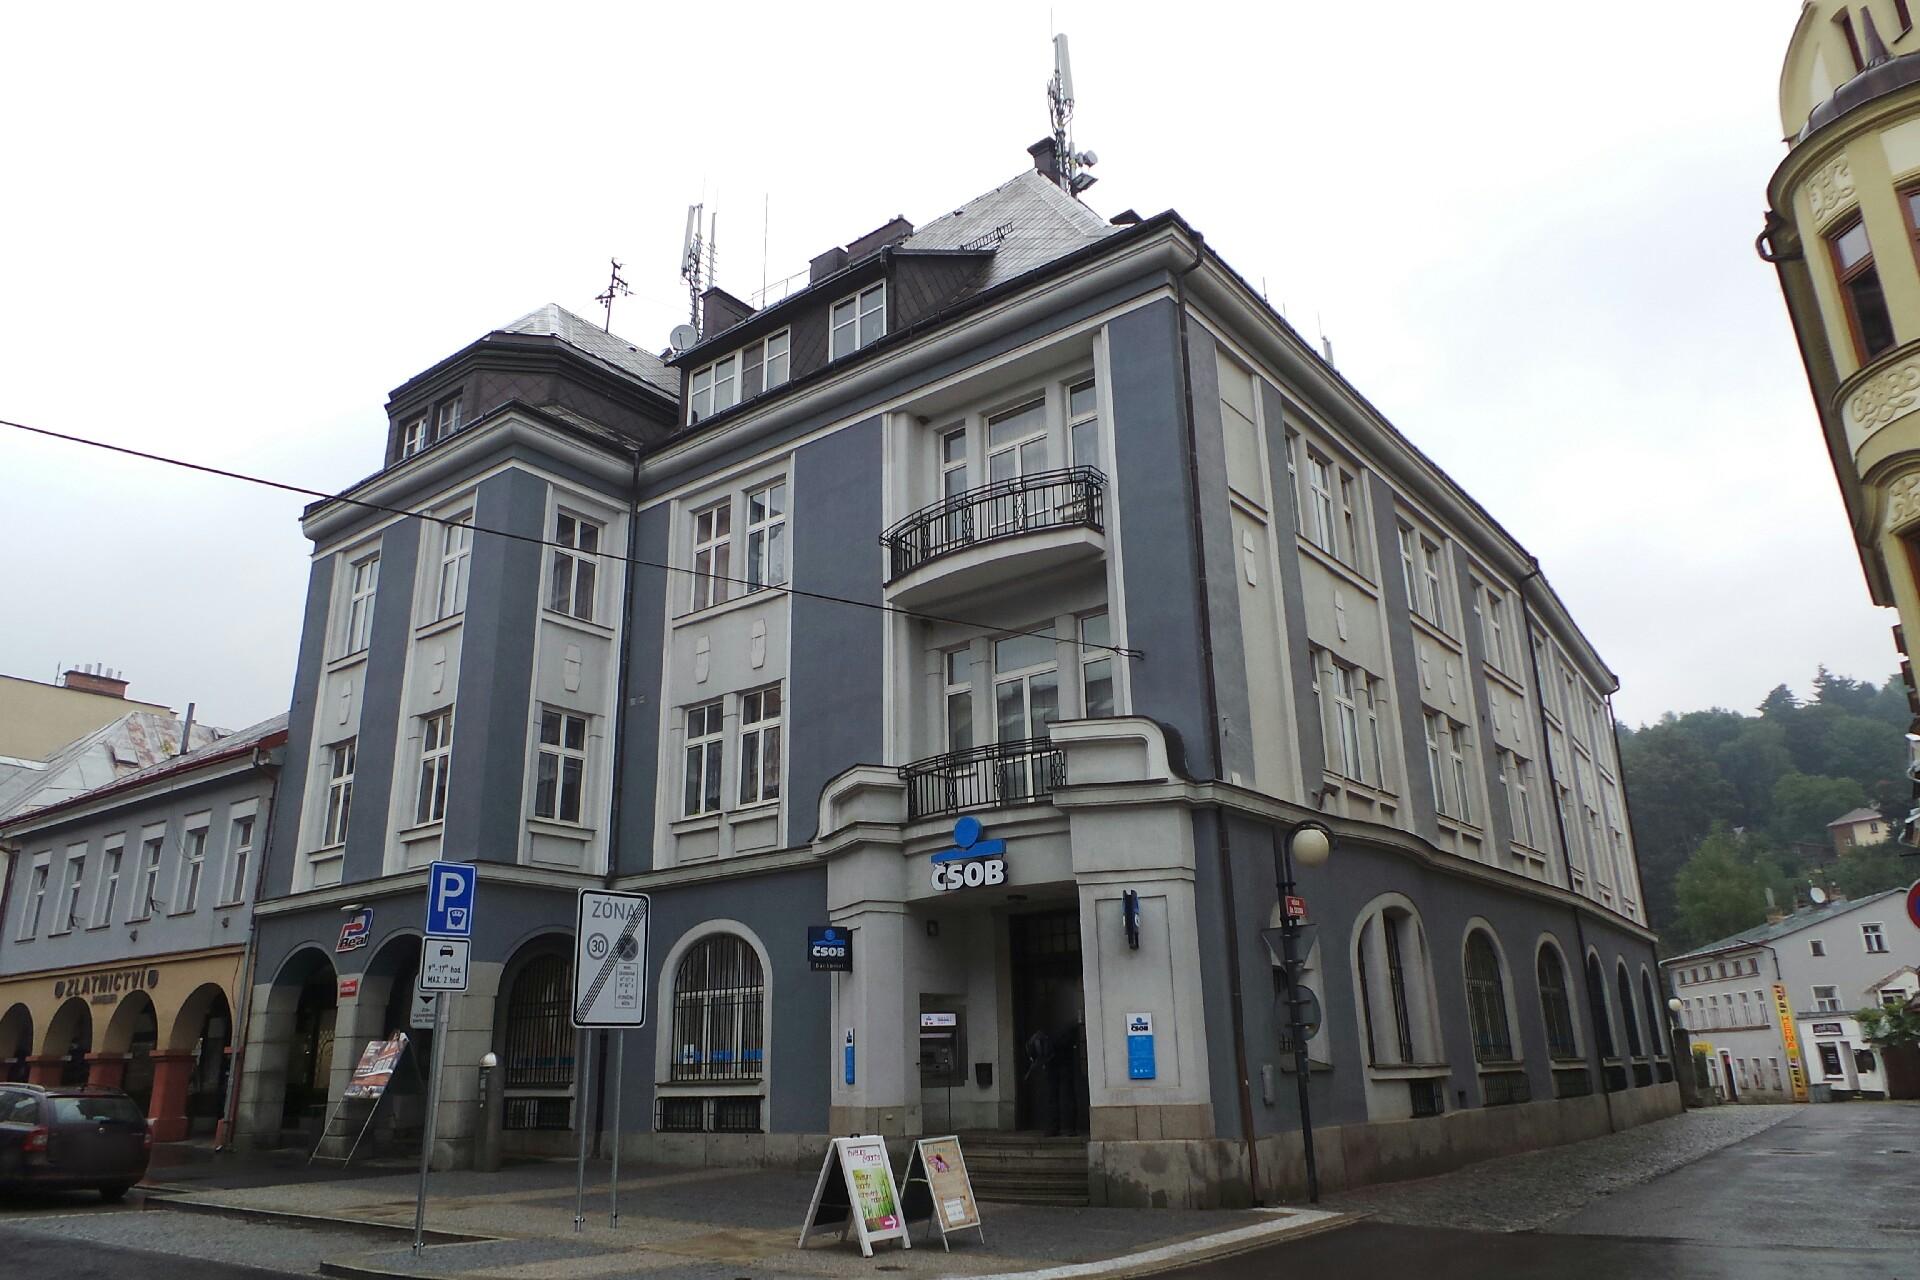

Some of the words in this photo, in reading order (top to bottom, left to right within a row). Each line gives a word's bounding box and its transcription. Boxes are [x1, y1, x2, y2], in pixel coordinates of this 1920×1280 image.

[931, 860, 1006, 891] ČSOB
[437, 871, 466, 912] P
[591, 897, 636, 920] ZÓNA
[340, 934, 368, 948] Real
[591, 939, 605, 953] 30
[812, 945, 845, 957] ČSOB
[66, 966, 147, 997] ZLATNICTVÍ
